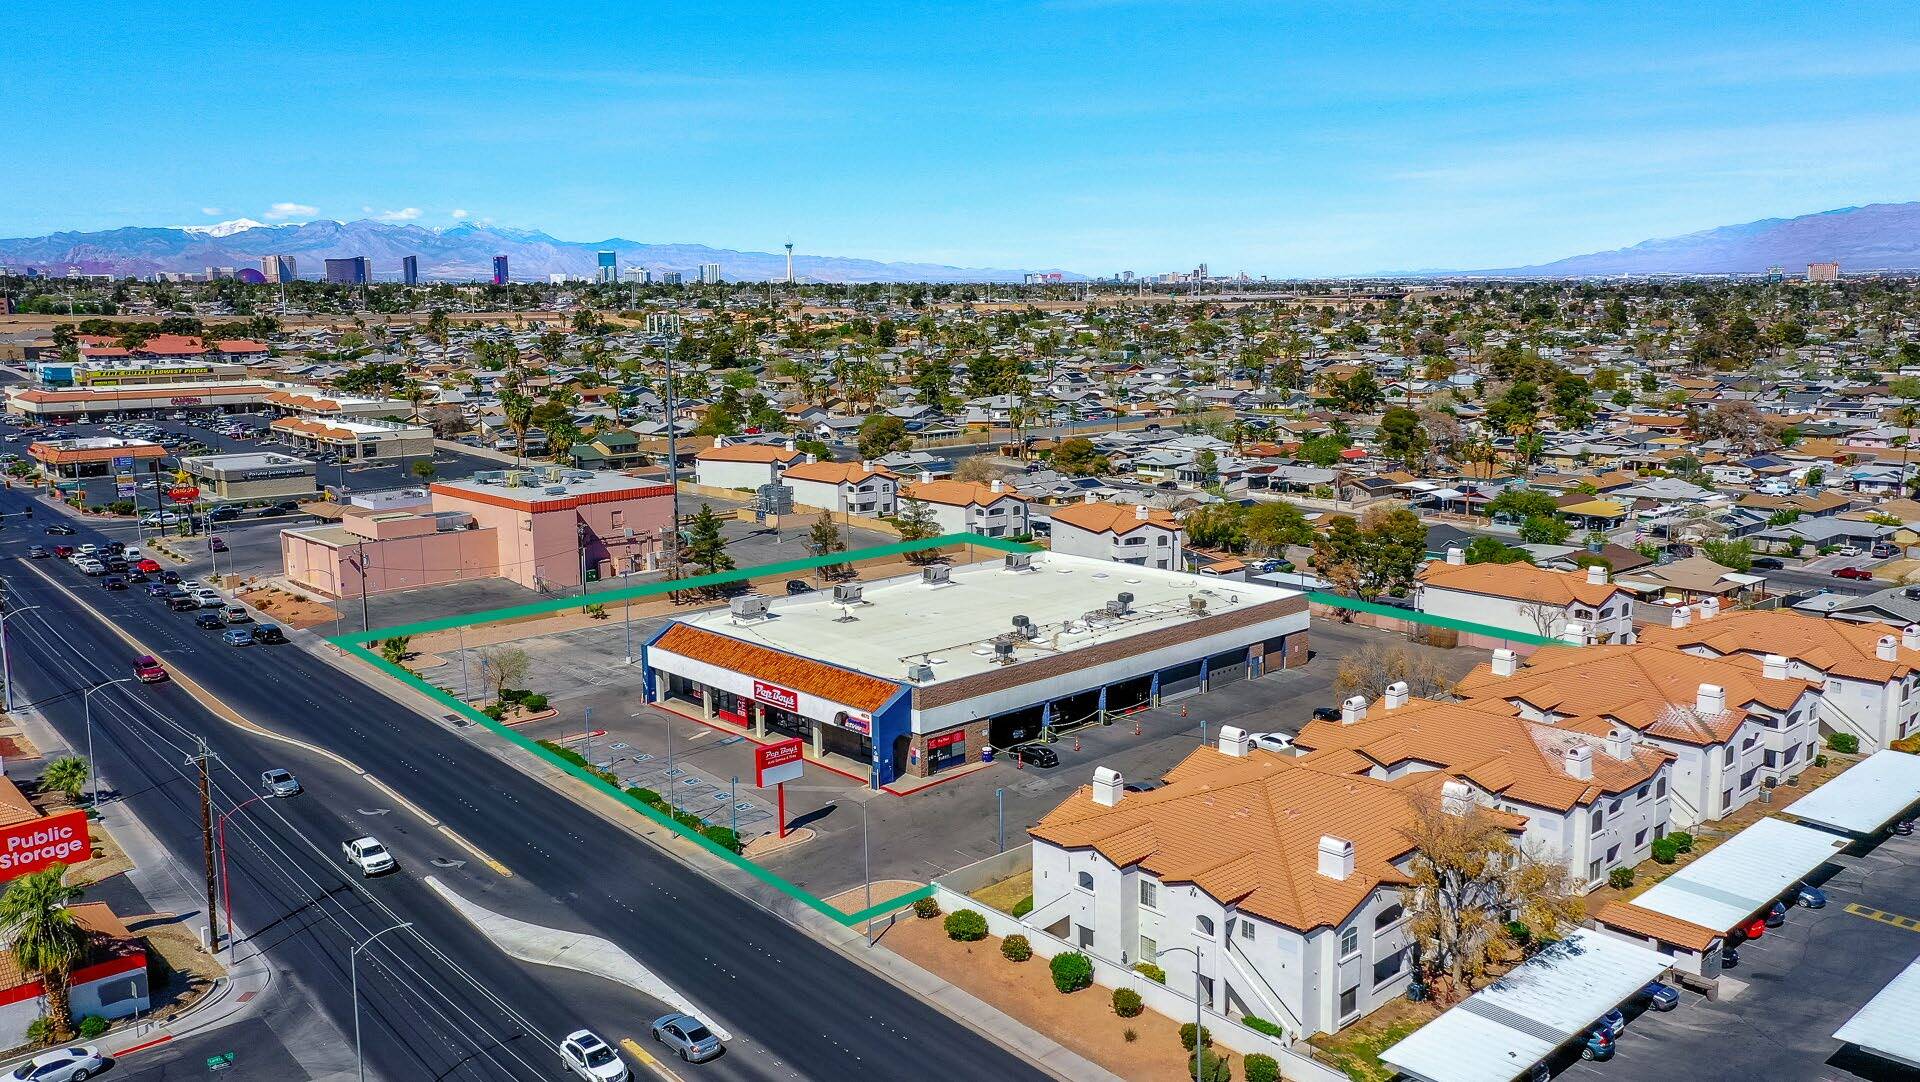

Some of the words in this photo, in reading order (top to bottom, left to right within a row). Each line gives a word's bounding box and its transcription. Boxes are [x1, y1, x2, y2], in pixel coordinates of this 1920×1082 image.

[755, 683, 772, 700] Pep
[771, 688, 795, 708] Boys
[765, 751, 779, 760] Pep
[780, 745, 798, 757] Boys
[7, 827, 73, 852] Public
[0, 840, 82, 869] Storage
